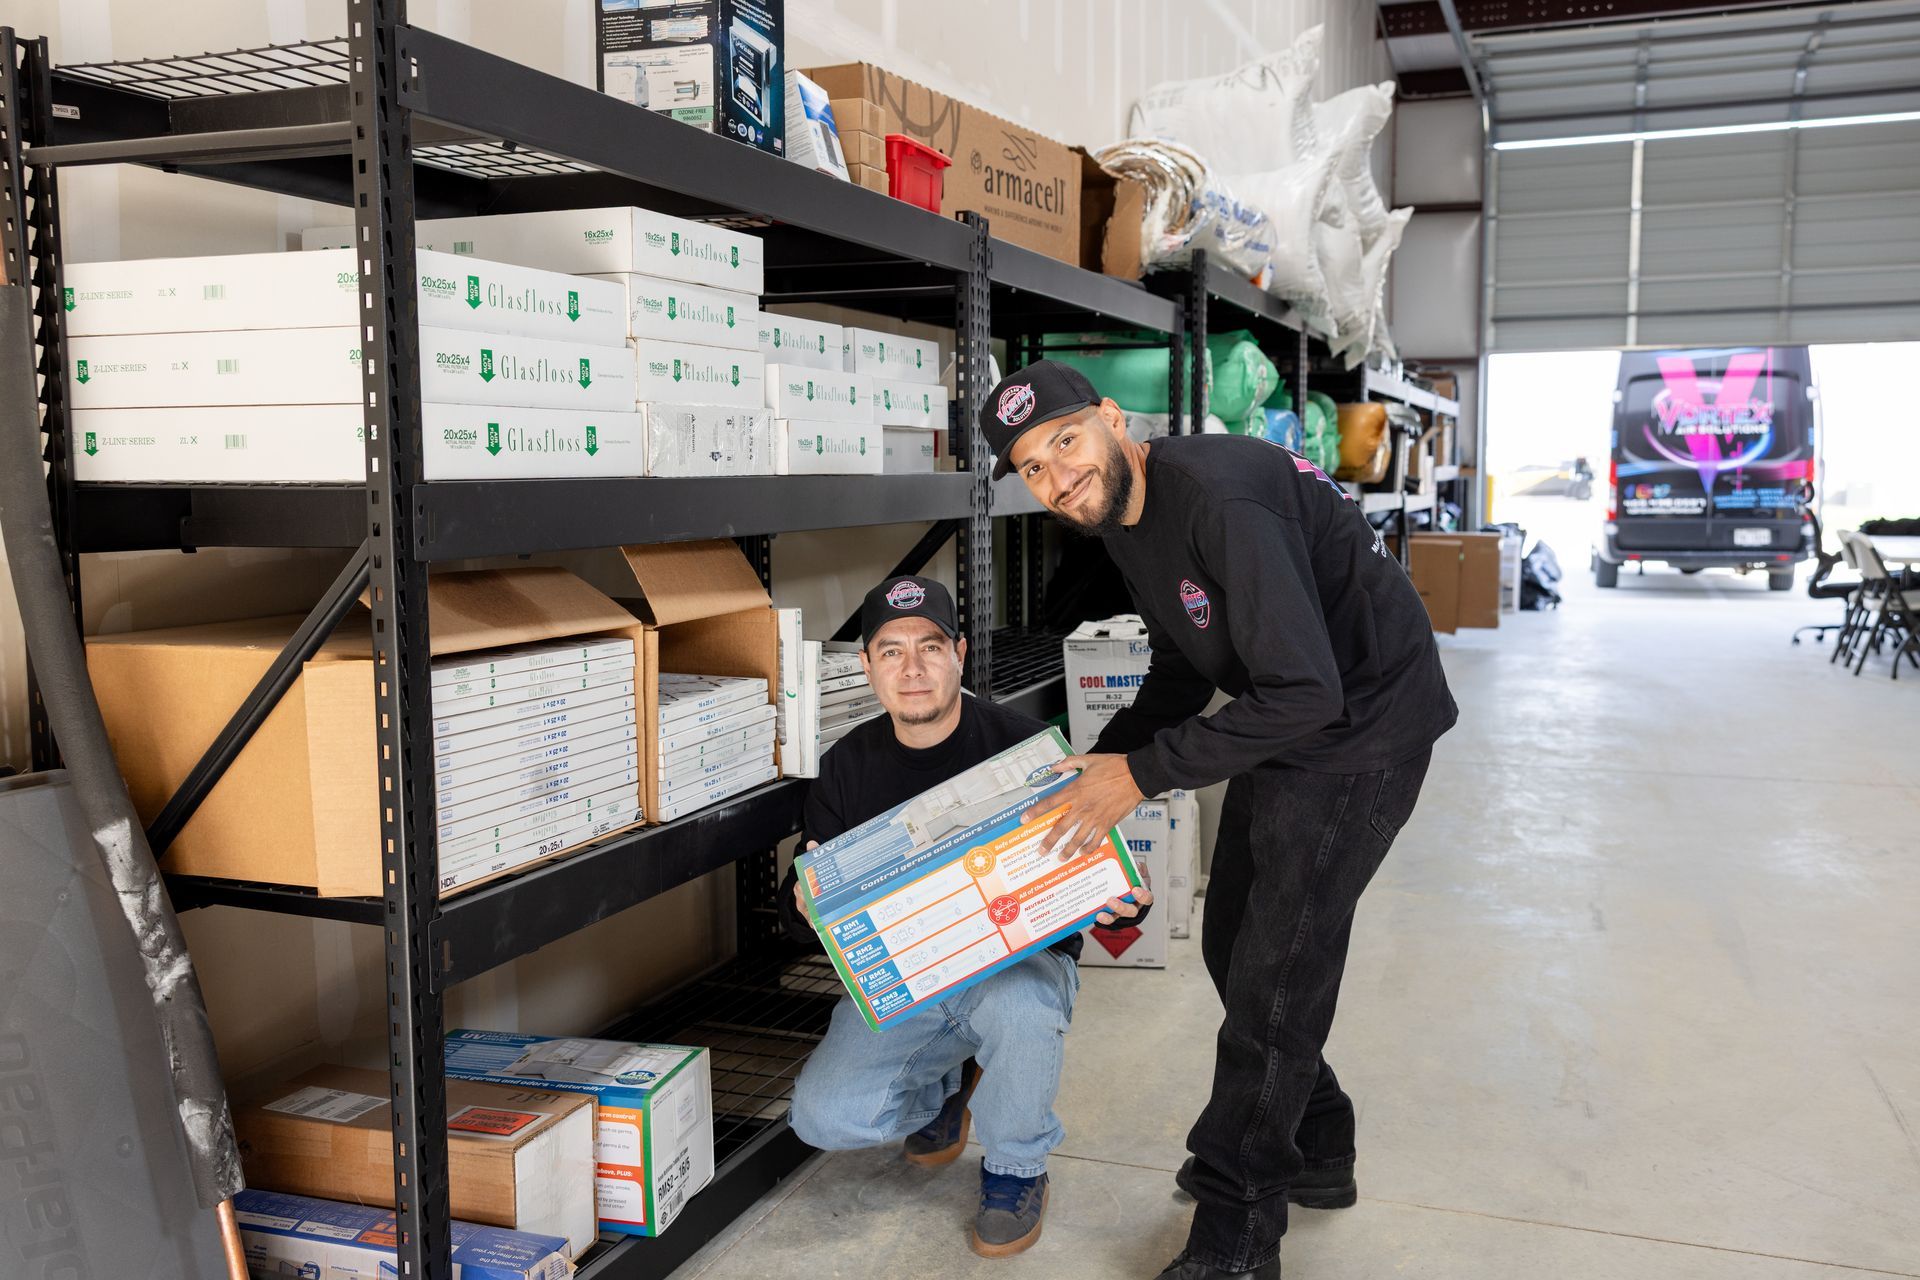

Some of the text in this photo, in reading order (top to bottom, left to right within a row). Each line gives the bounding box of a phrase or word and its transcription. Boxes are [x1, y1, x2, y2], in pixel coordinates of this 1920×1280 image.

[984, 165, 1064, 216] armacell
[584, 230, 614, 239] 16x25x4
[645, 232, 666, 242] 16x25x4
[683, 238, 728, 264] Glasfloss
[421, 276, 456, 290] 20x25x4
[106, 290, 133, 299] SERIES
[488, 282, 562, 315] Glasfloss
[680, 302, 724, 324] Glasfloss
[783, 333, 817, 350] Glasfloss
[436, 353, 470, 365] 20x25x4
[120, 363, 147, 372] SERIES
[501, 355, 573, 383] Glasfloss
[649, 362, 669, 371] 16x25x4
[684, 365, 729, 383] Glasfloss
[996, 383, 1034, 426] VORTEX
[1013, 403, 1031, 422] SOLUTIONS
[1652, 398, 1775, 436] VORTEX
[444, 429, 477, 440] 20x25x4
[1698, 423, 1770, 435] SOLUTIONS
[128, 437, 156, 445] SERIES
[508, 428, 580, 452] Glasfloss
[885, 588, 926, 606] VORTEX
[1136, 806, 1162, 818] iGas
[995, 814, 1062, 851] Safe and effective germ
[812, 842, 836, 858] UV
[861, 868, 899, 890] Control
[900, 852, 932, 871] germs
[933, 840, 952, 854] and
[954, 825, 982, 844] odors
[990, 796, 1039, 825] naturally!
[1001, 845, 1031, 863] INACTIVATE
[1008, 864, 1027, 876] REDUCE
[1044, 871, 1068, 886] benefits
[1068, 861, 1088, 874] above,
[1087, 852, 1104, 862] PLUS:
[440, 876, 456, 889] HDX
[822, 880, 840, 890] RM3
[1024, 893, 1055, 911] NEUTRALIZE
[1030, 910, 1051, 923] REMOVE
[1091, 881, 1108, 892] pressed
[843, 919, 859, 931] RM1
[856, 944, 874, 956] RM2
[868, 968, 886, 981] RM2
[881, 991, 898, 1003] RM3
[556, 1083, 605, 1092] naturally!
[491, 1258, 521, 1267] Choosing
